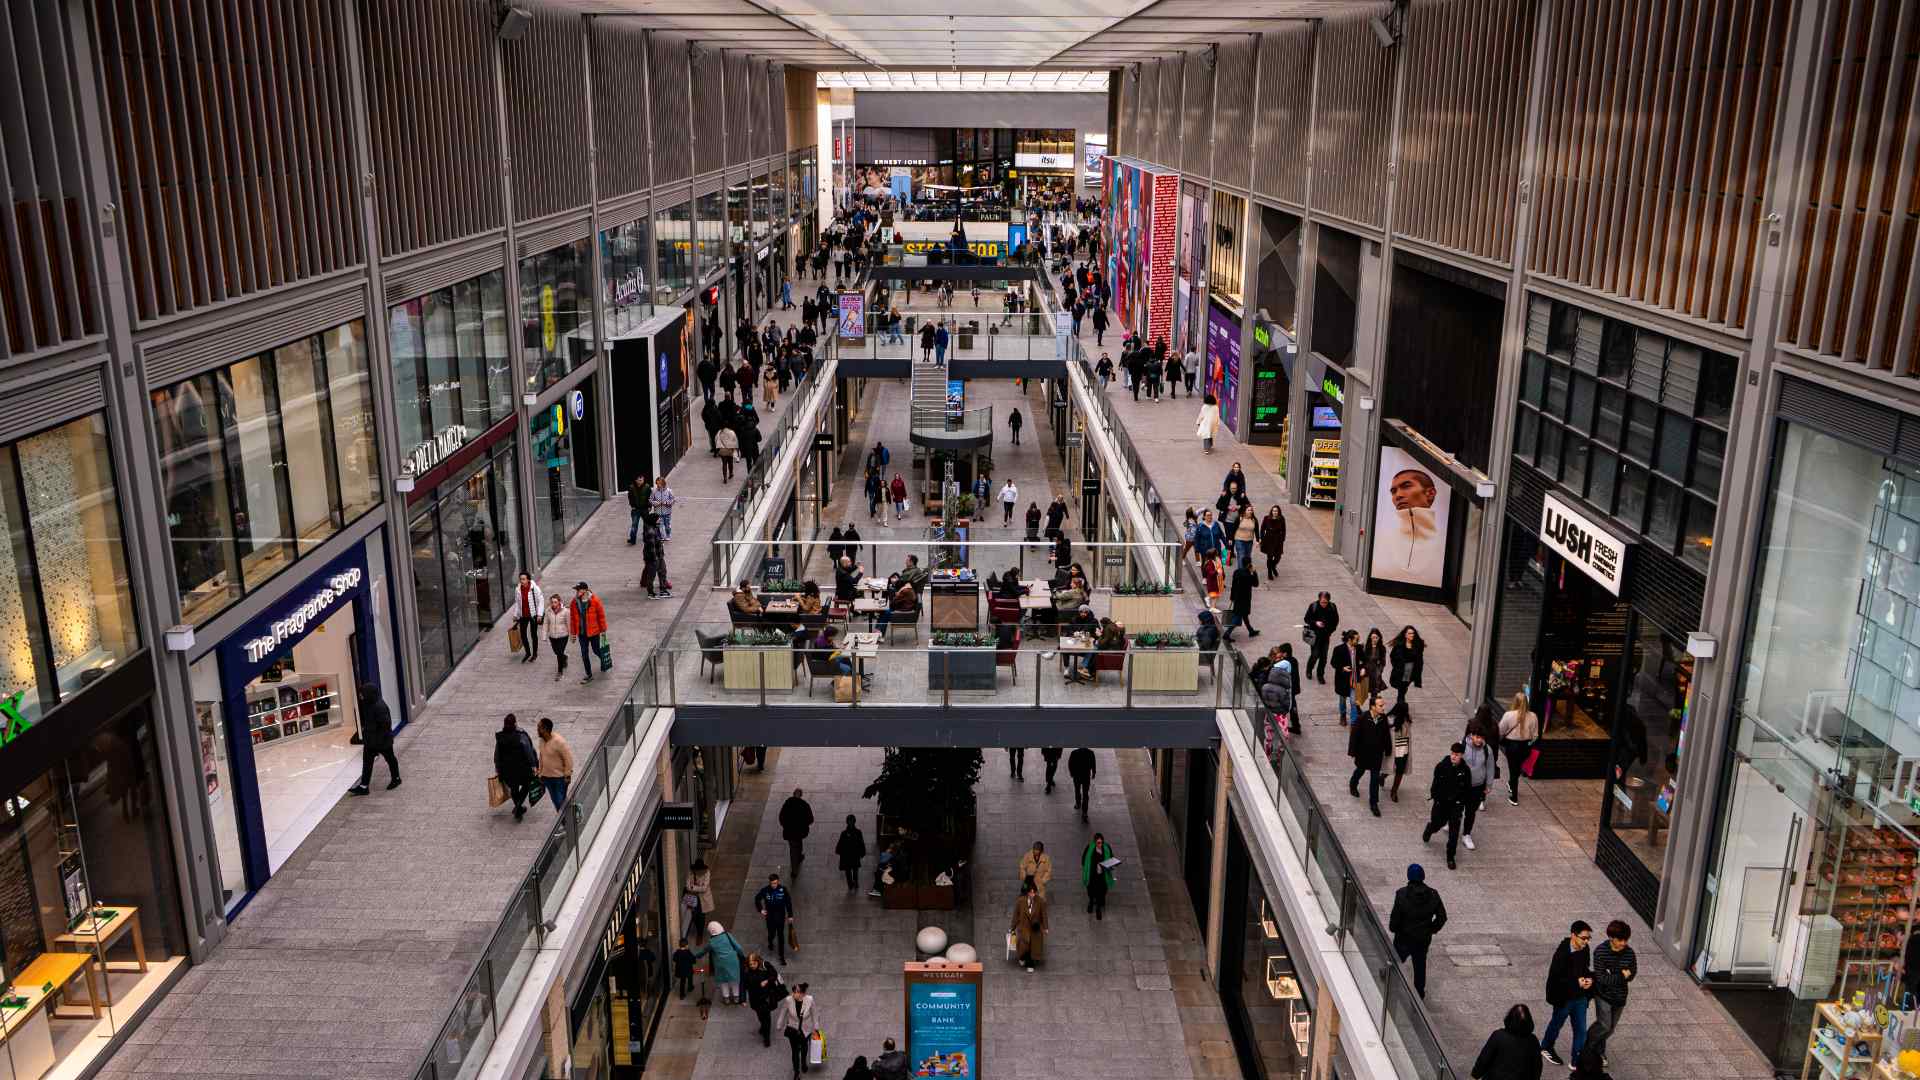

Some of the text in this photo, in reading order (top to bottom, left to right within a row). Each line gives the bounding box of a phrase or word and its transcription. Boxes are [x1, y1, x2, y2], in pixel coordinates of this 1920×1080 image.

[1041, 155, 1056, 165] itsu
[416, 441, 433, 476] PRET
[438, 426, 463, 461] MANGER
[1545, 507, 1593, 565] LUSH
[1594, 539, 1618, 564] FRESH
[247, 567, 361, 662] The Fragrance Shop
[915, 1002, 971, 1010] COMMUNITY
[931, 1016, 955, 1024] BANK
